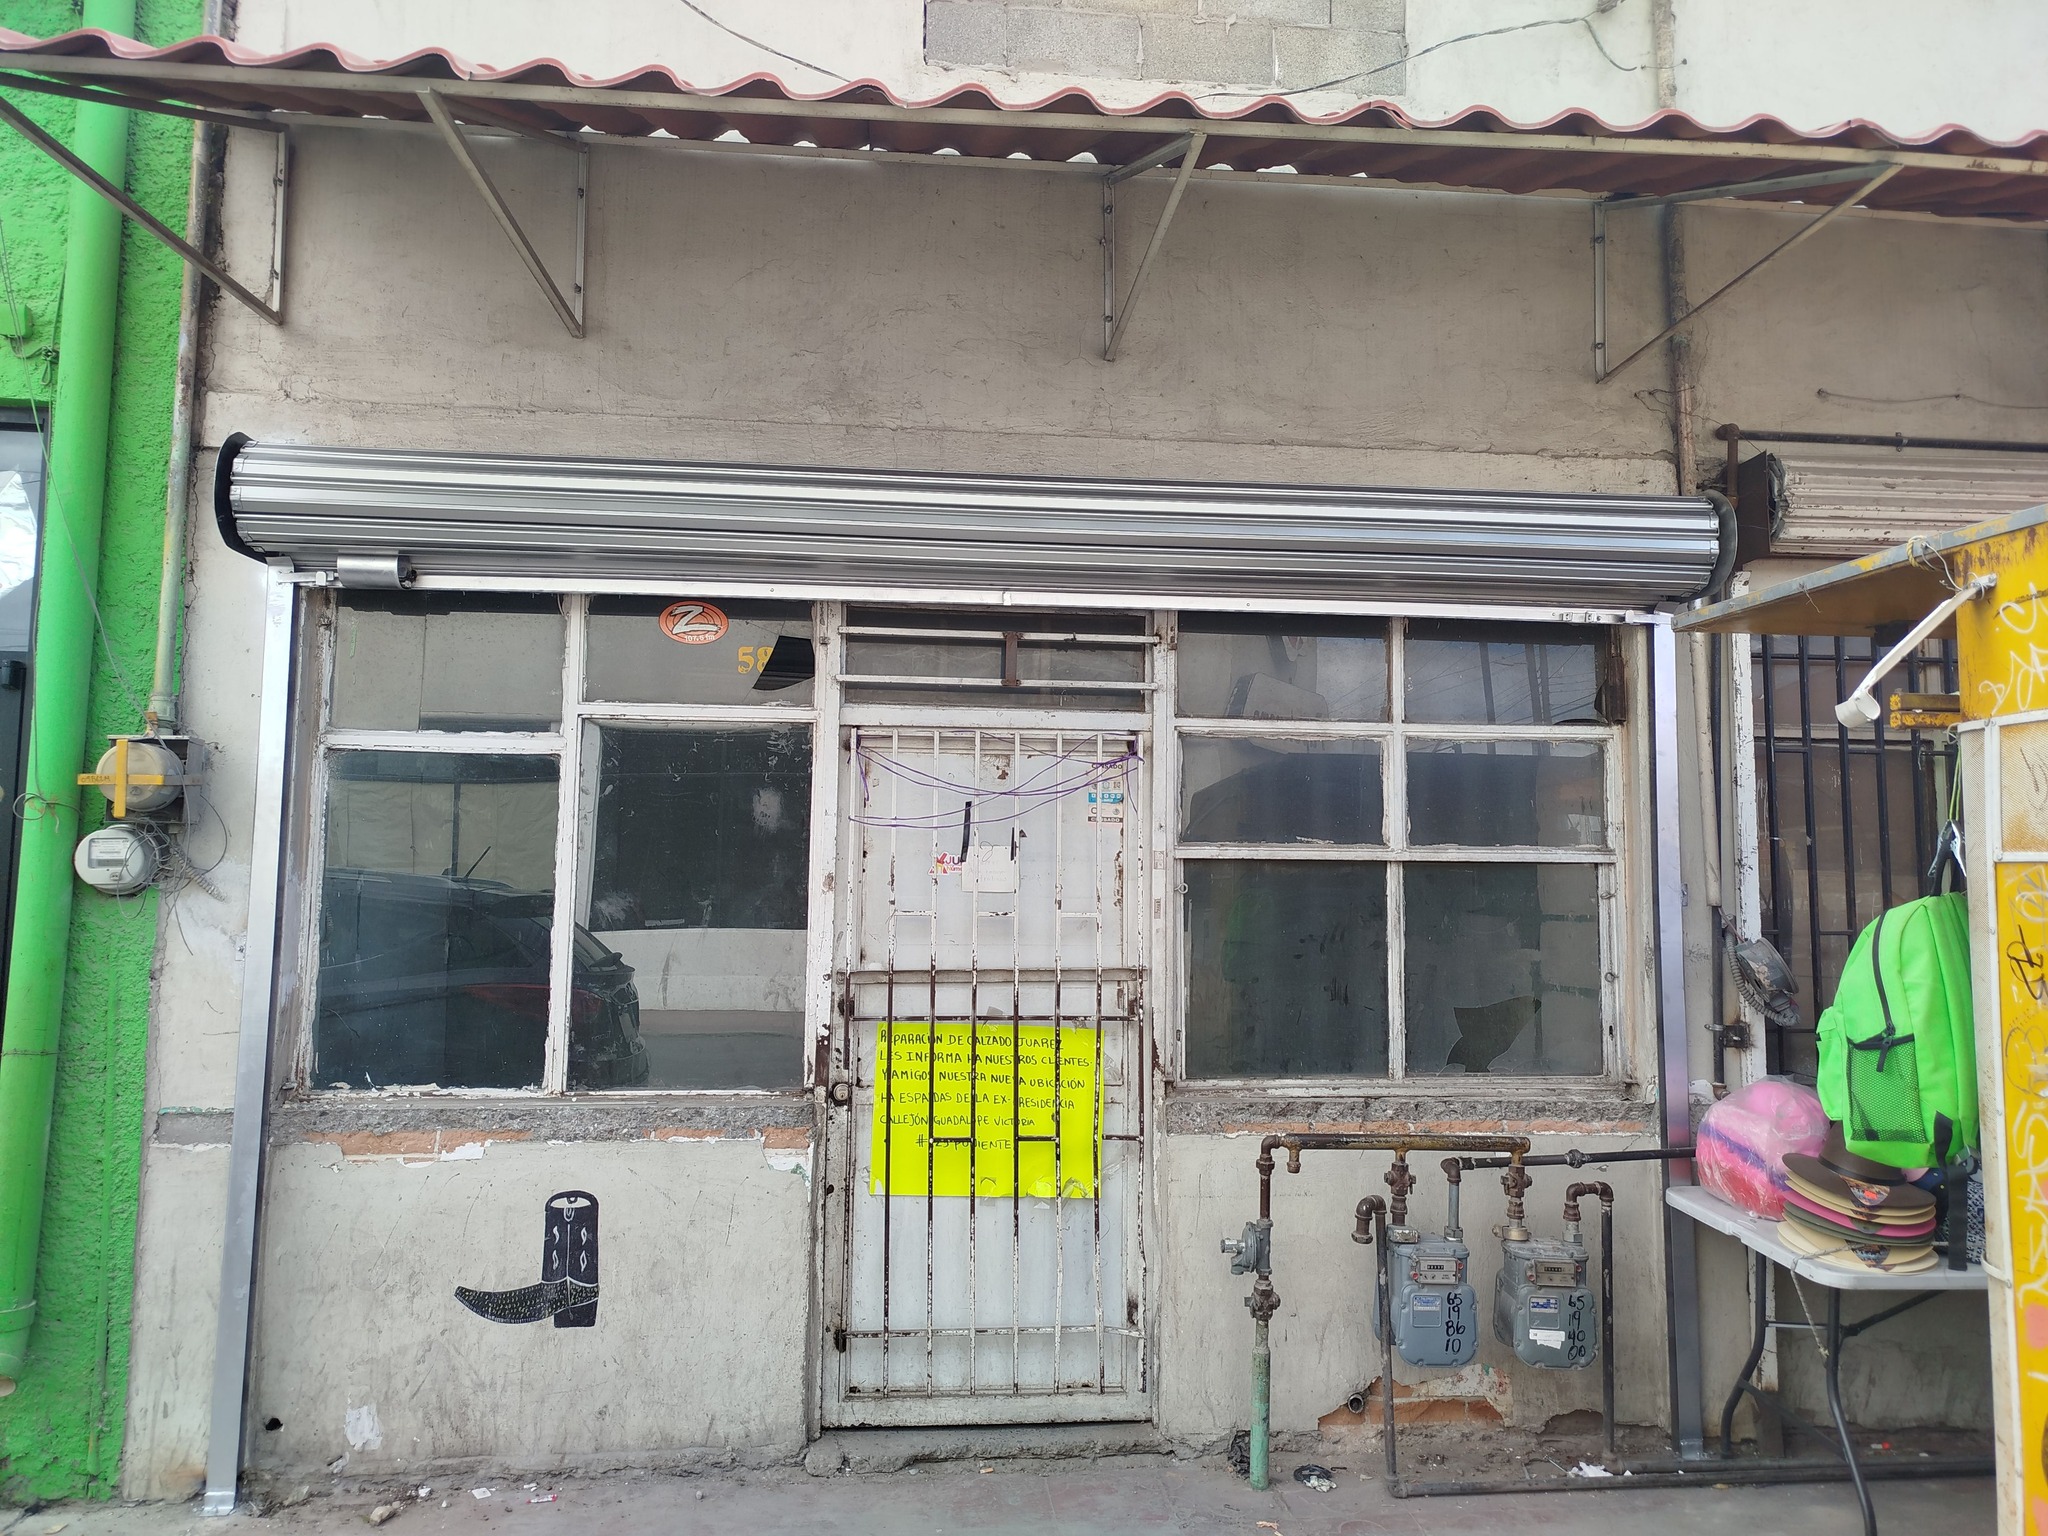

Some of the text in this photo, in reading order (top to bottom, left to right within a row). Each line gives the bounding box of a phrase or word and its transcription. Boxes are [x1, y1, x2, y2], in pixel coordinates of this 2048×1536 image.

[881, 1029, 943, 1046] RPARACIN
[946, 1034, 964, 1046] DE
[966, 1035, 1012, 1047] CALZADO
[990, 1073, 1027, 1085] NUEA
[1030, 1077, 1085, 1089] UBICCIÓN
[899, 1092, 952, 1104] ESPADAS
[956, 1092, 970, 1103] DE
[975, 1093, 990, 1103] LA
[933, 1115, 990, 1126] GUADALPE
[994, 1116, 1035, 1126] VICTRIA
[1446, 1291, 1463, 1306] 65
[1567, 1294, 1585, 1310] 65
[1447, 1306, 1461, 1321] 19
[1567, 1330, 1586, 1346] 40
[1445, 1338, 1462, 1355] 10
